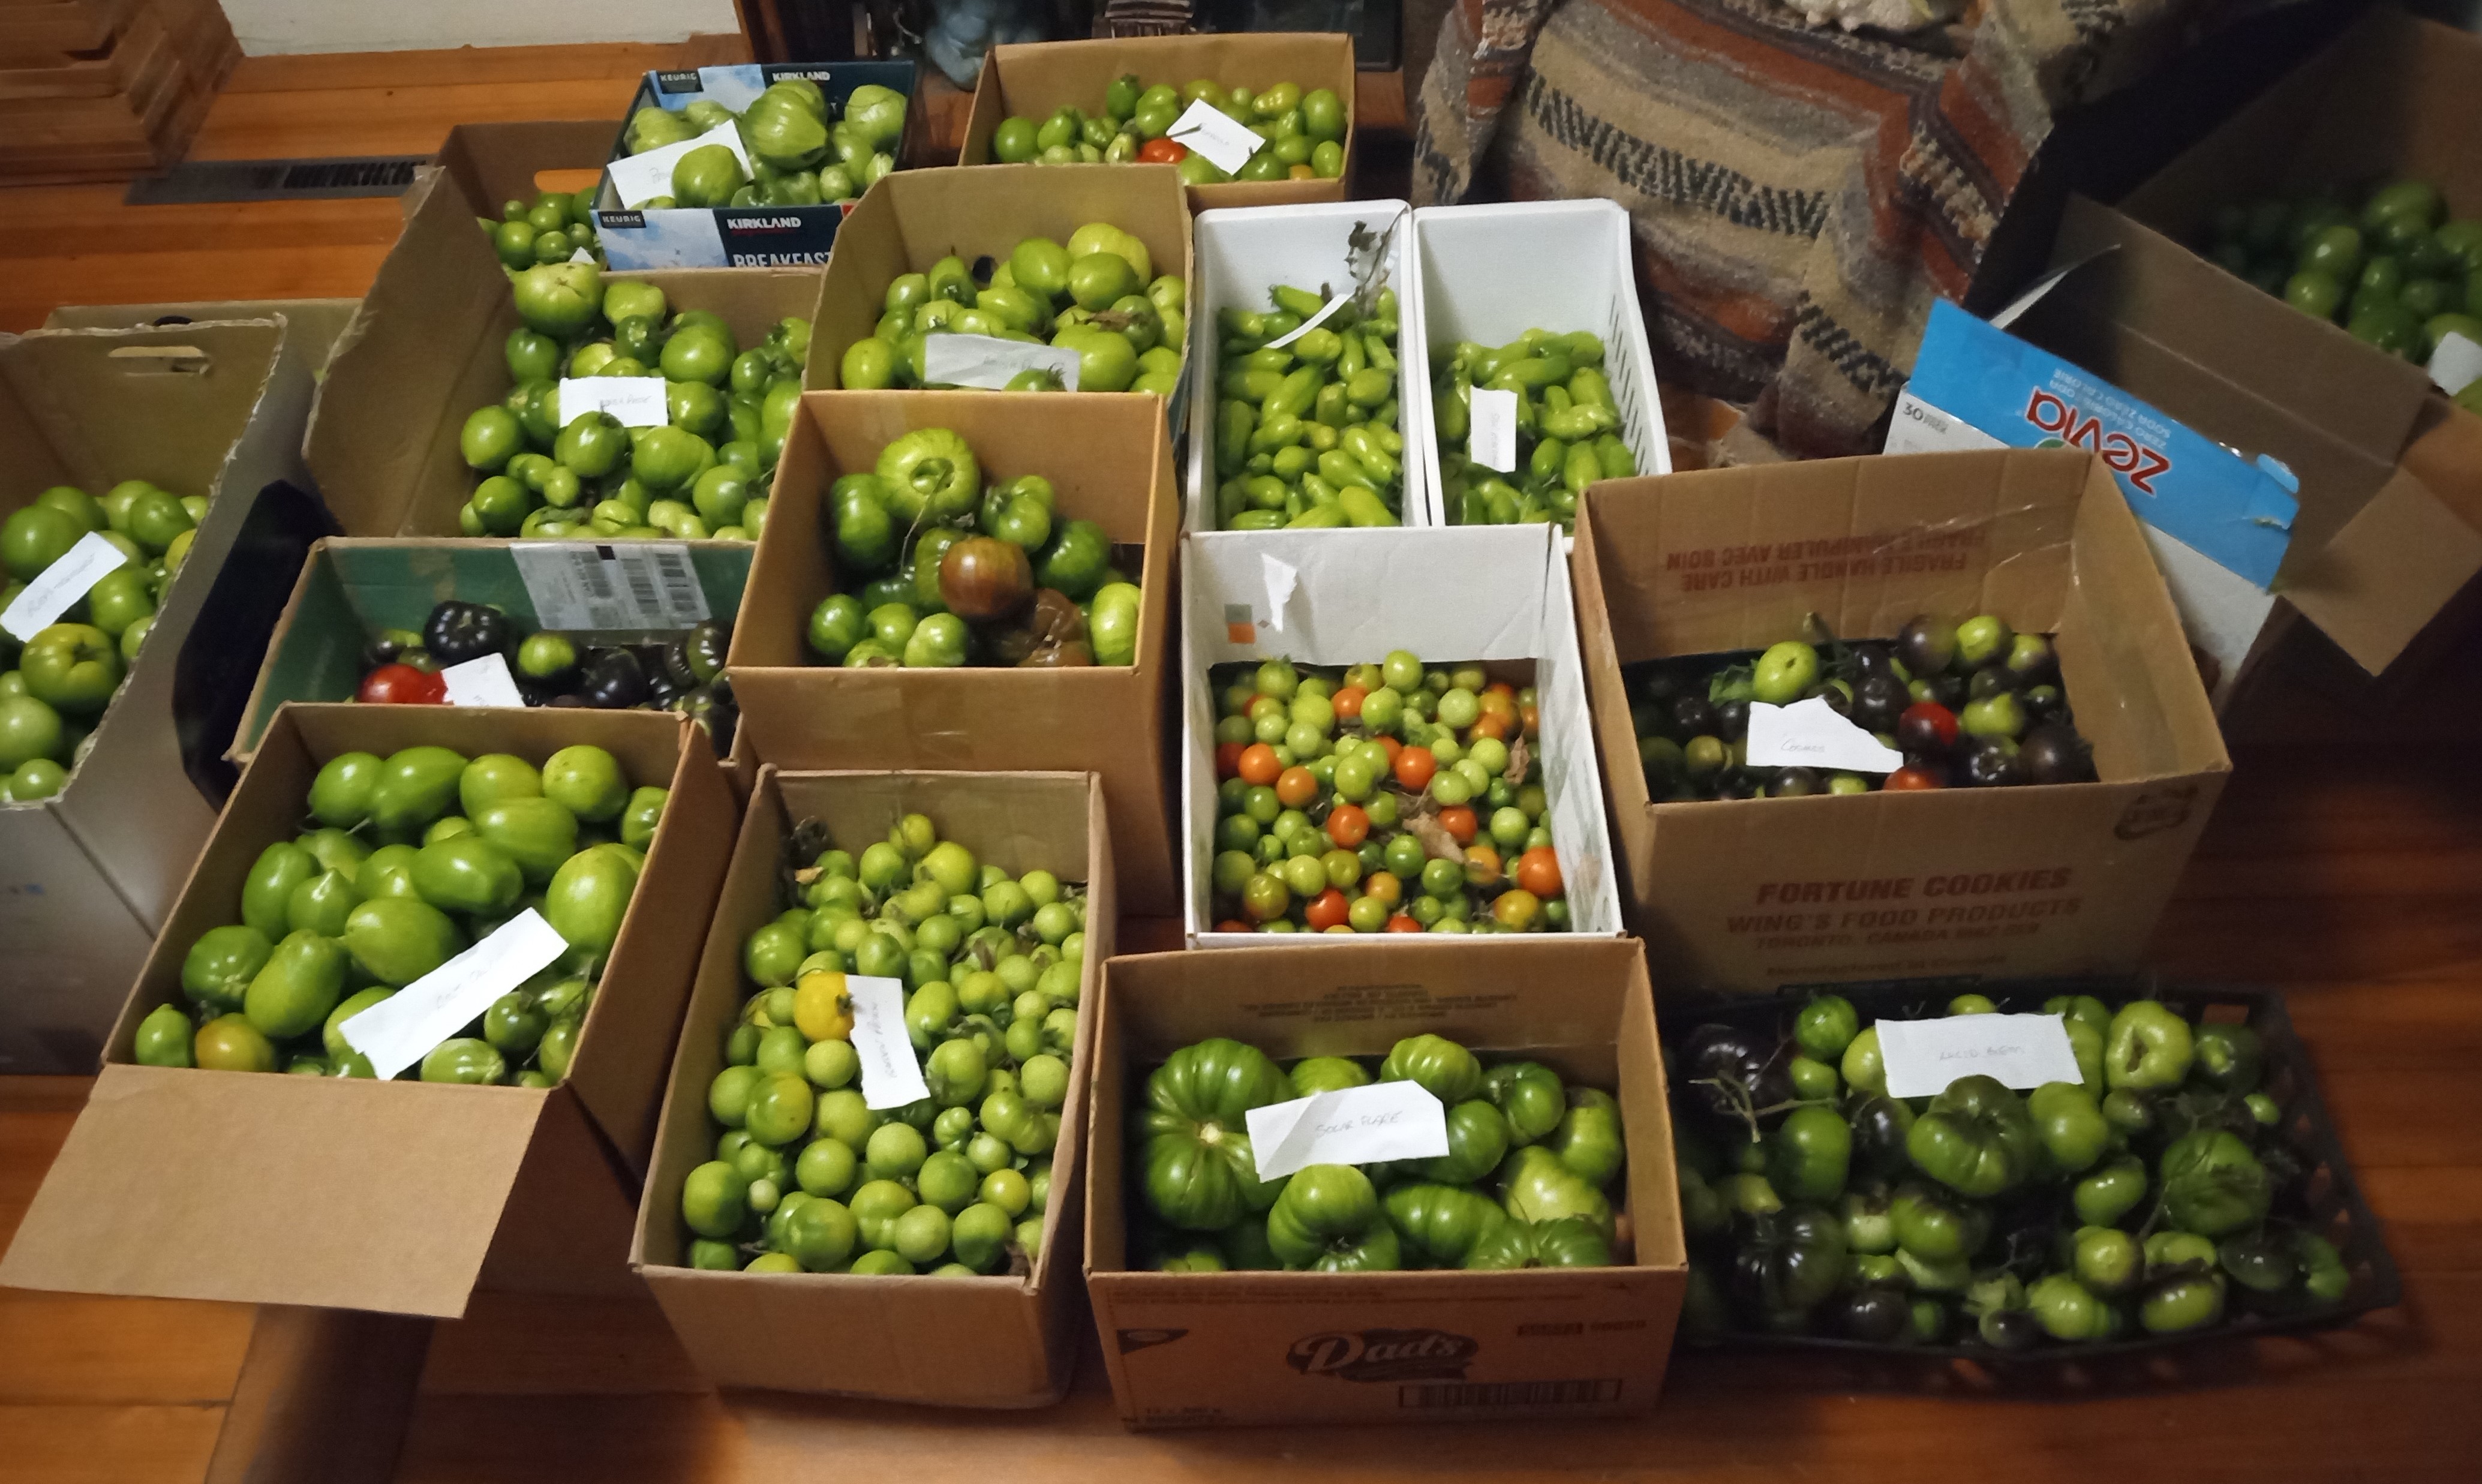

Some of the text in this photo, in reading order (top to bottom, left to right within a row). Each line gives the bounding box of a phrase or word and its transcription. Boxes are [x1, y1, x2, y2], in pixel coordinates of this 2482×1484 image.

[660, 73, 696, 82] KEURIG
[772, 71, 831, 81] KIRKLAND
[602, 215, 641, 223] KEURIG
[727, 217, 801, 230] KIRKLAND
[1903, 401, 1924, 421] 30
[2026, 386, 2172, 498] zevia
[1666, 549, 1715, 571] SOIN
[1680, 570, 1733, 592] CARE
[1756, 867, 2073, 905] FORTUNE COOKIES
[1726, 896, 2084, 933] WING'S FOOD PRODUCTS
